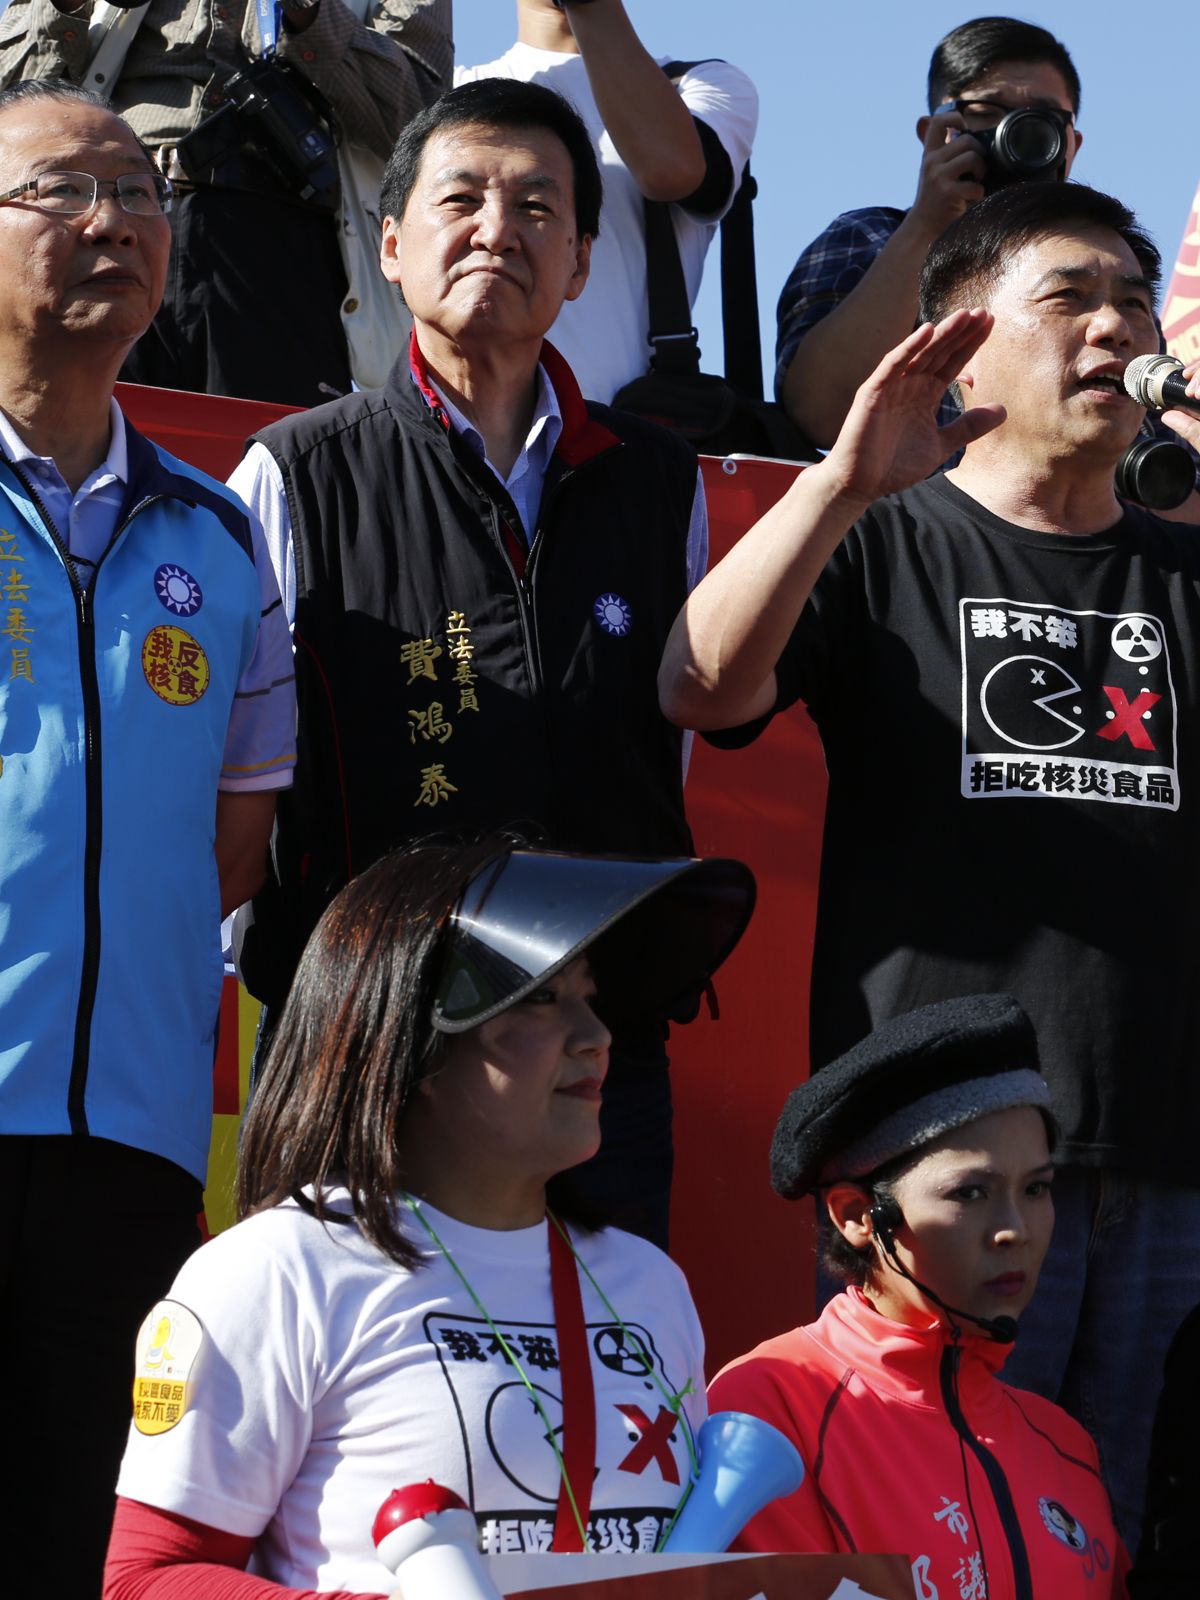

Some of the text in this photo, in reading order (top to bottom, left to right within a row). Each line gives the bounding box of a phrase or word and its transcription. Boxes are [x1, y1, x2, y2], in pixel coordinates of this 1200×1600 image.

[970, 608, 1078, 650] 我不笨
[446, 610, 480, 715] 立法委員
[400, 638, 459, 808] 費鴻泰
[970, 761, 1175, 805] 拒吃核災食品
[438, 1328, 560, 1371] 我不笨
[482, 1516, 674, 1553] 拒吃災食
